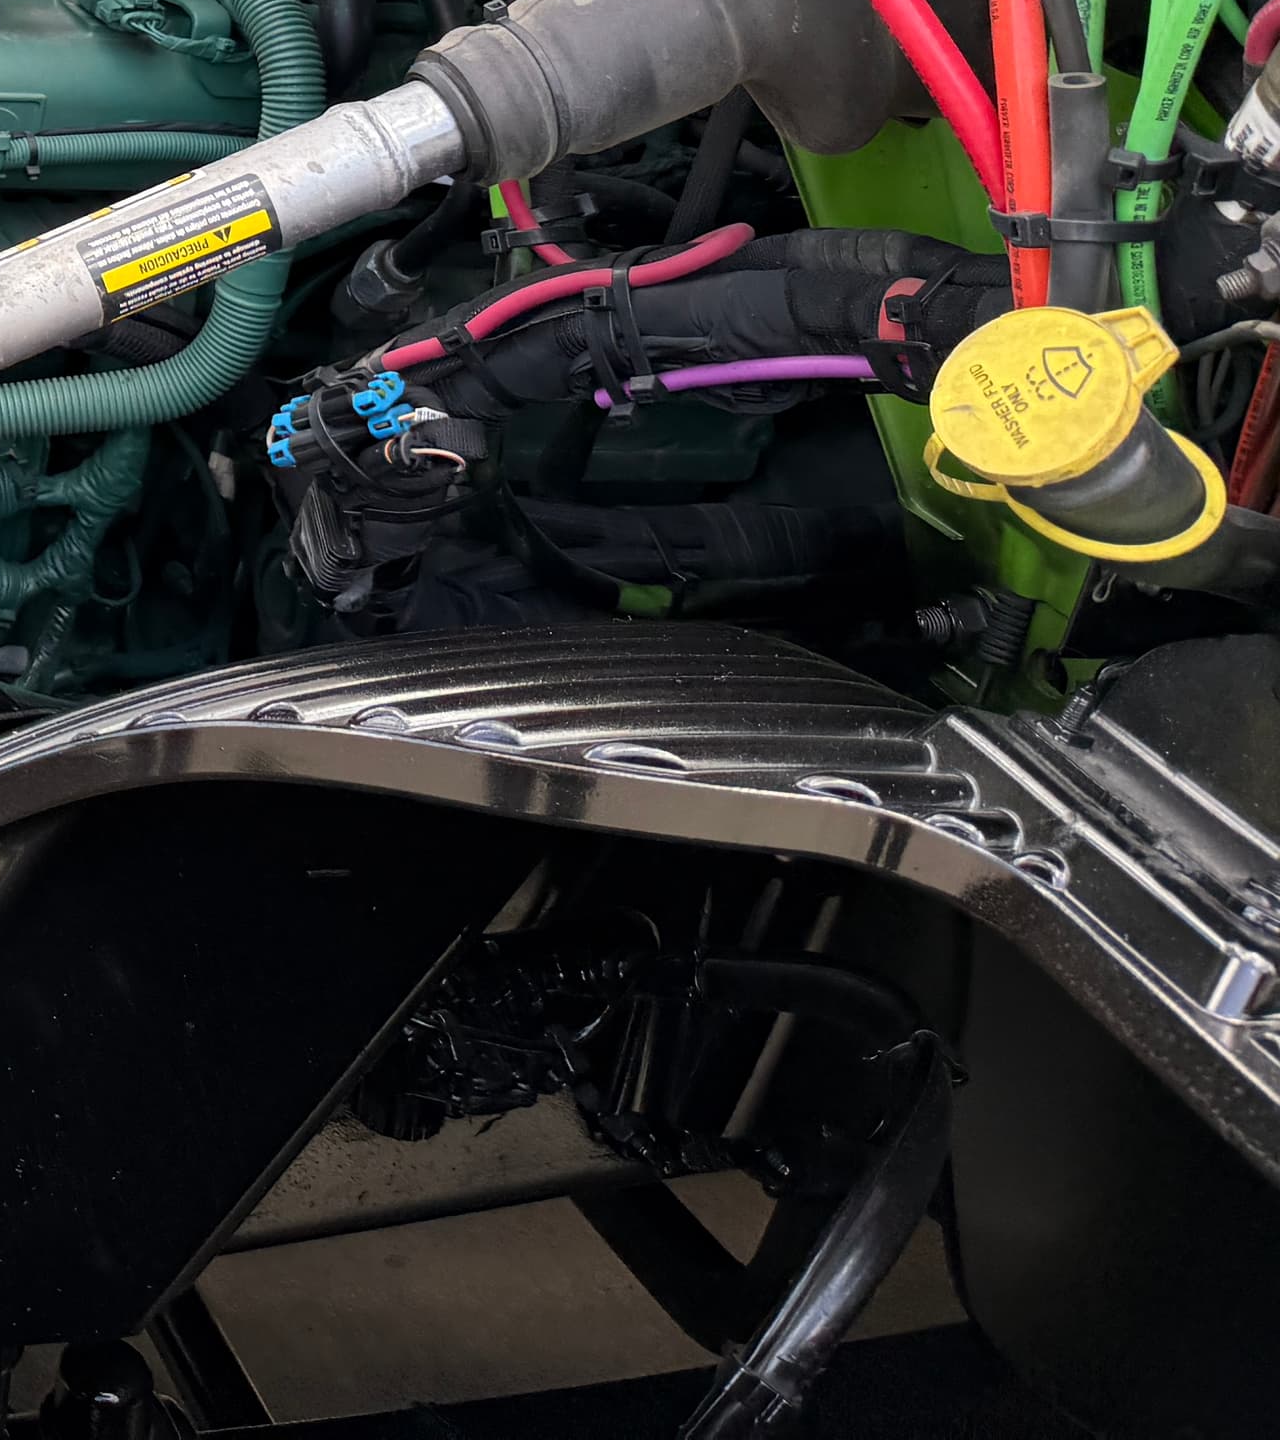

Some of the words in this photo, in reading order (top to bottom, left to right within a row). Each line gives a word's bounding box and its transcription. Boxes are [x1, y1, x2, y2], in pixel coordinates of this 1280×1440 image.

[139, 238, 210, 275] PRECAUCION
[969, 364, 998, 400] FLUID
[1001, 383, 1029, 414] ONLY
[989, 400, 1032, 450] WASHER
